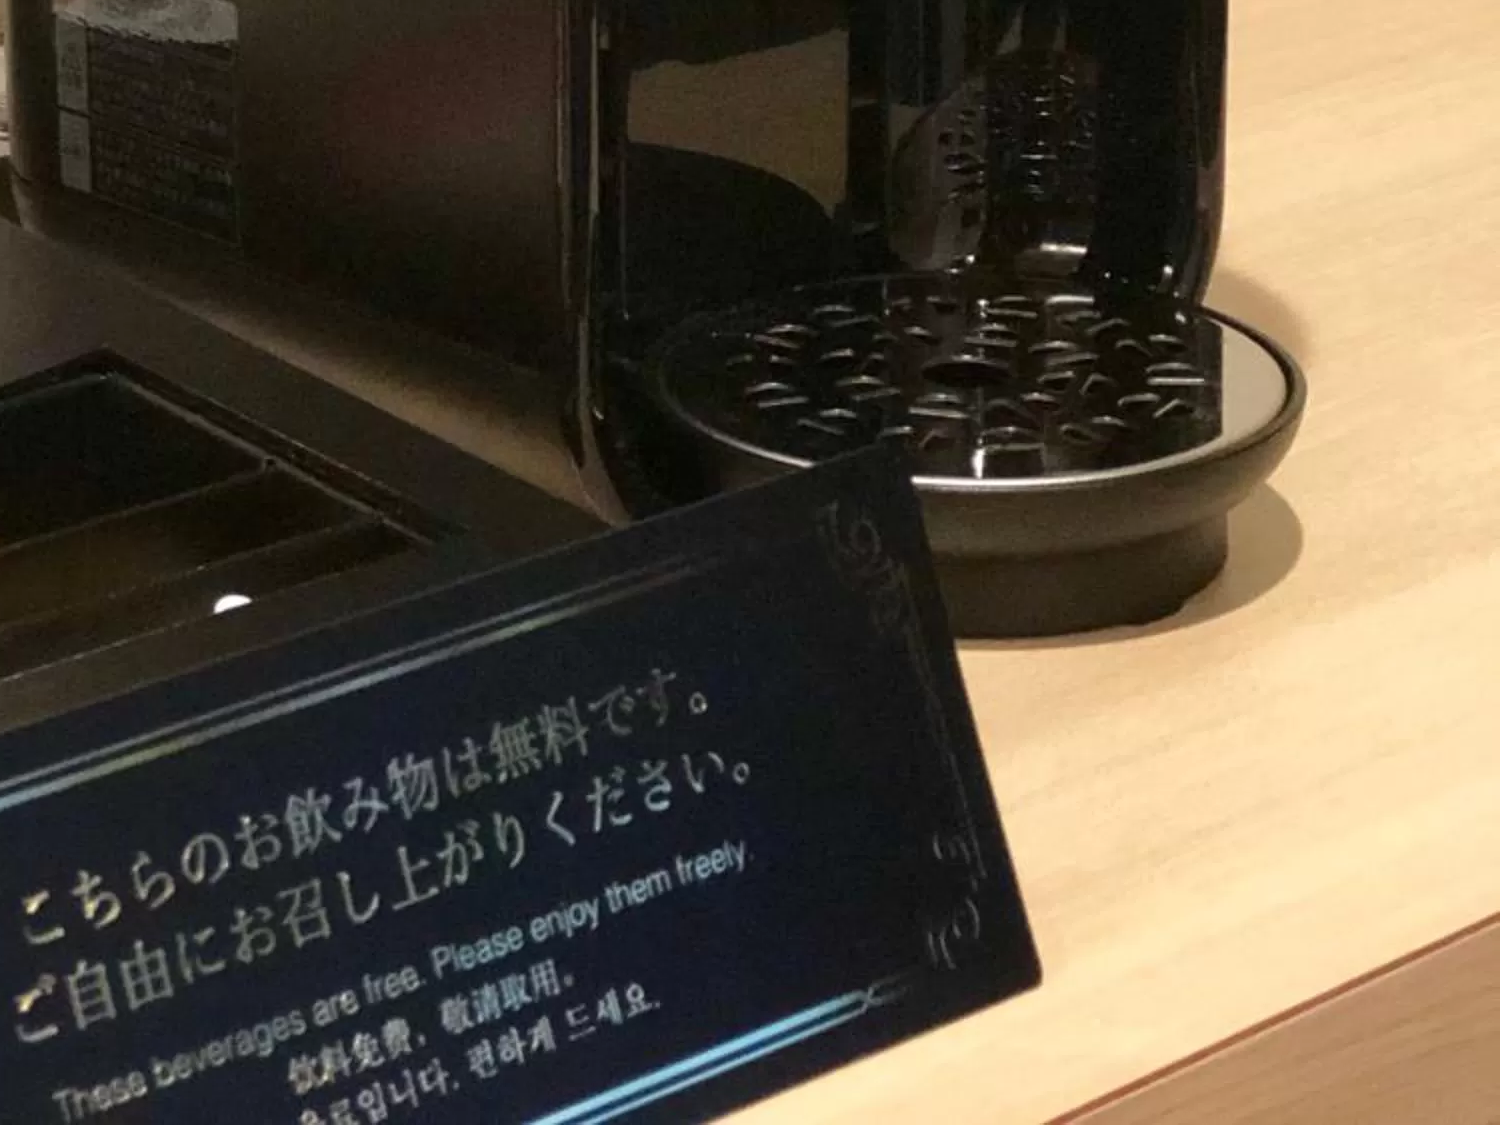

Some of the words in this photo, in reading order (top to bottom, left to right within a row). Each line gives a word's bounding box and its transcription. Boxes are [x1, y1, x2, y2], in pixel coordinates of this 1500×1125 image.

[12, 751, 751, 1043] ご自由にお召し上がりください。
[21, 668, 709, 945] こちらのお飲み物は無料です。
[52, 1071, 148, 1124] These
[152, 1008, 307, 1088] beverages
[311, 988, 361, 1027] are
[362, 965, 427, 1004] free.
[430, 924, 525, 980] Please
[529, 896, 601, 939] enjoy
[604, 868, 673, 914] them
